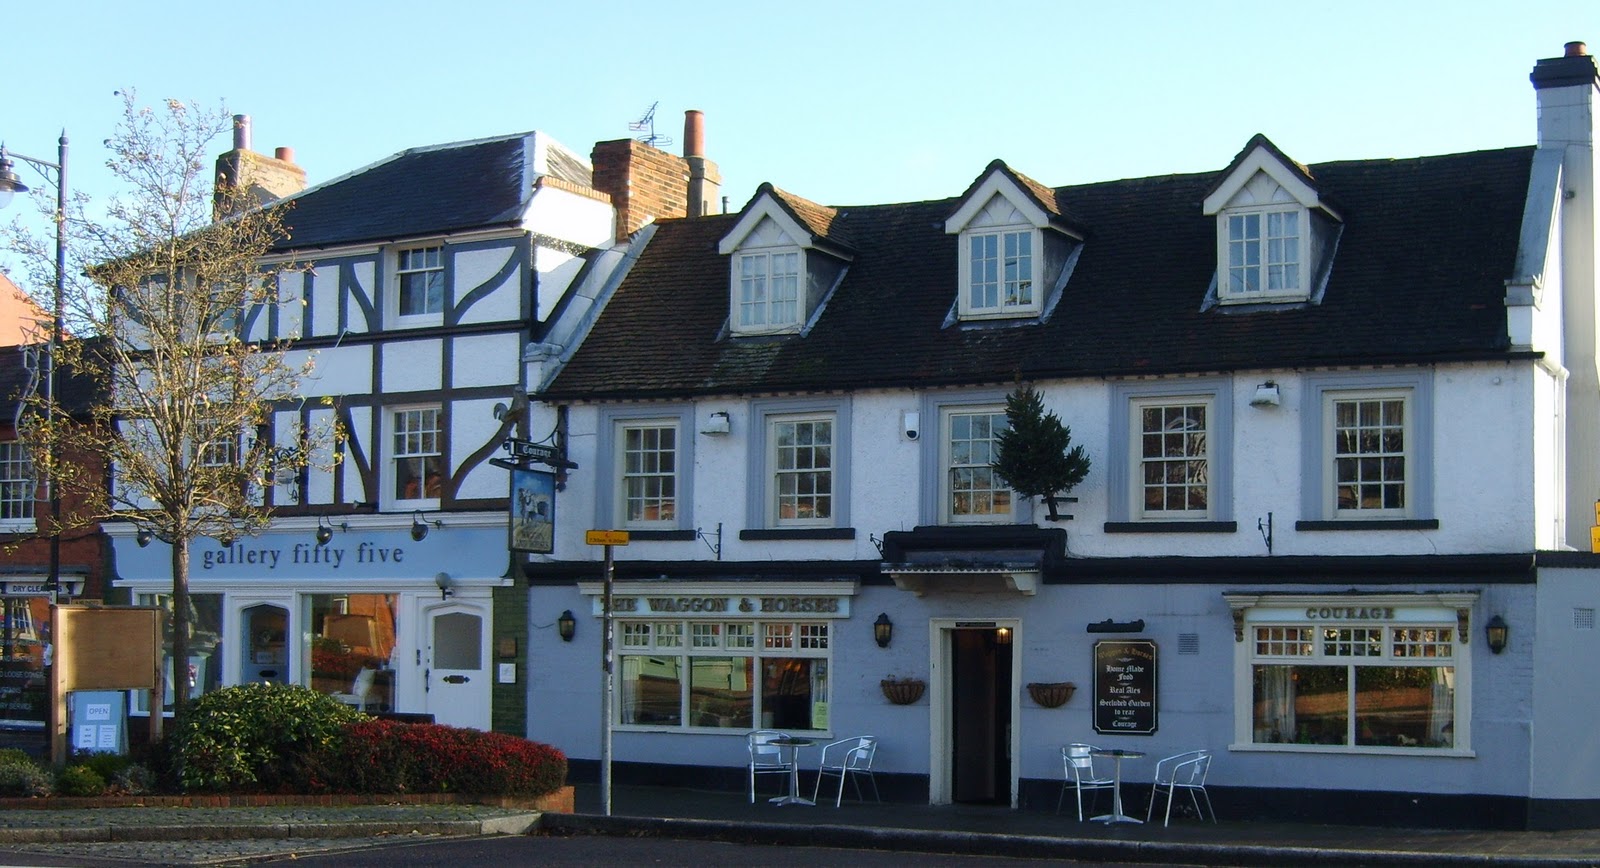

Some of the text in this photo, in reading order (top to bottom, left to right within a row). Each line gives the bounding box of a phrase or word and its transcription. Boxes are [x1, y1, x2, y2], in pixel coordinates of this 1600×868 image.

[203, 542, 404, 570] gallery fifty five
[646, 597, 729, 612] WAGGON
[739, 597, 754, 612] &
[760, 597, 839, 612] HORSES
[1305, 607, 1395, 619] COURAGE
[1106, 664, 1144, 673] Home Made
[1117, 673, 1134, 681] Food
[1109, 686, 1141, 694] Real Ales
[1099, 699, 1151, 707] Secluded Garden
[88, 707, 109, 715] OPEN
[1112, 720, 1137, 728] Courage
